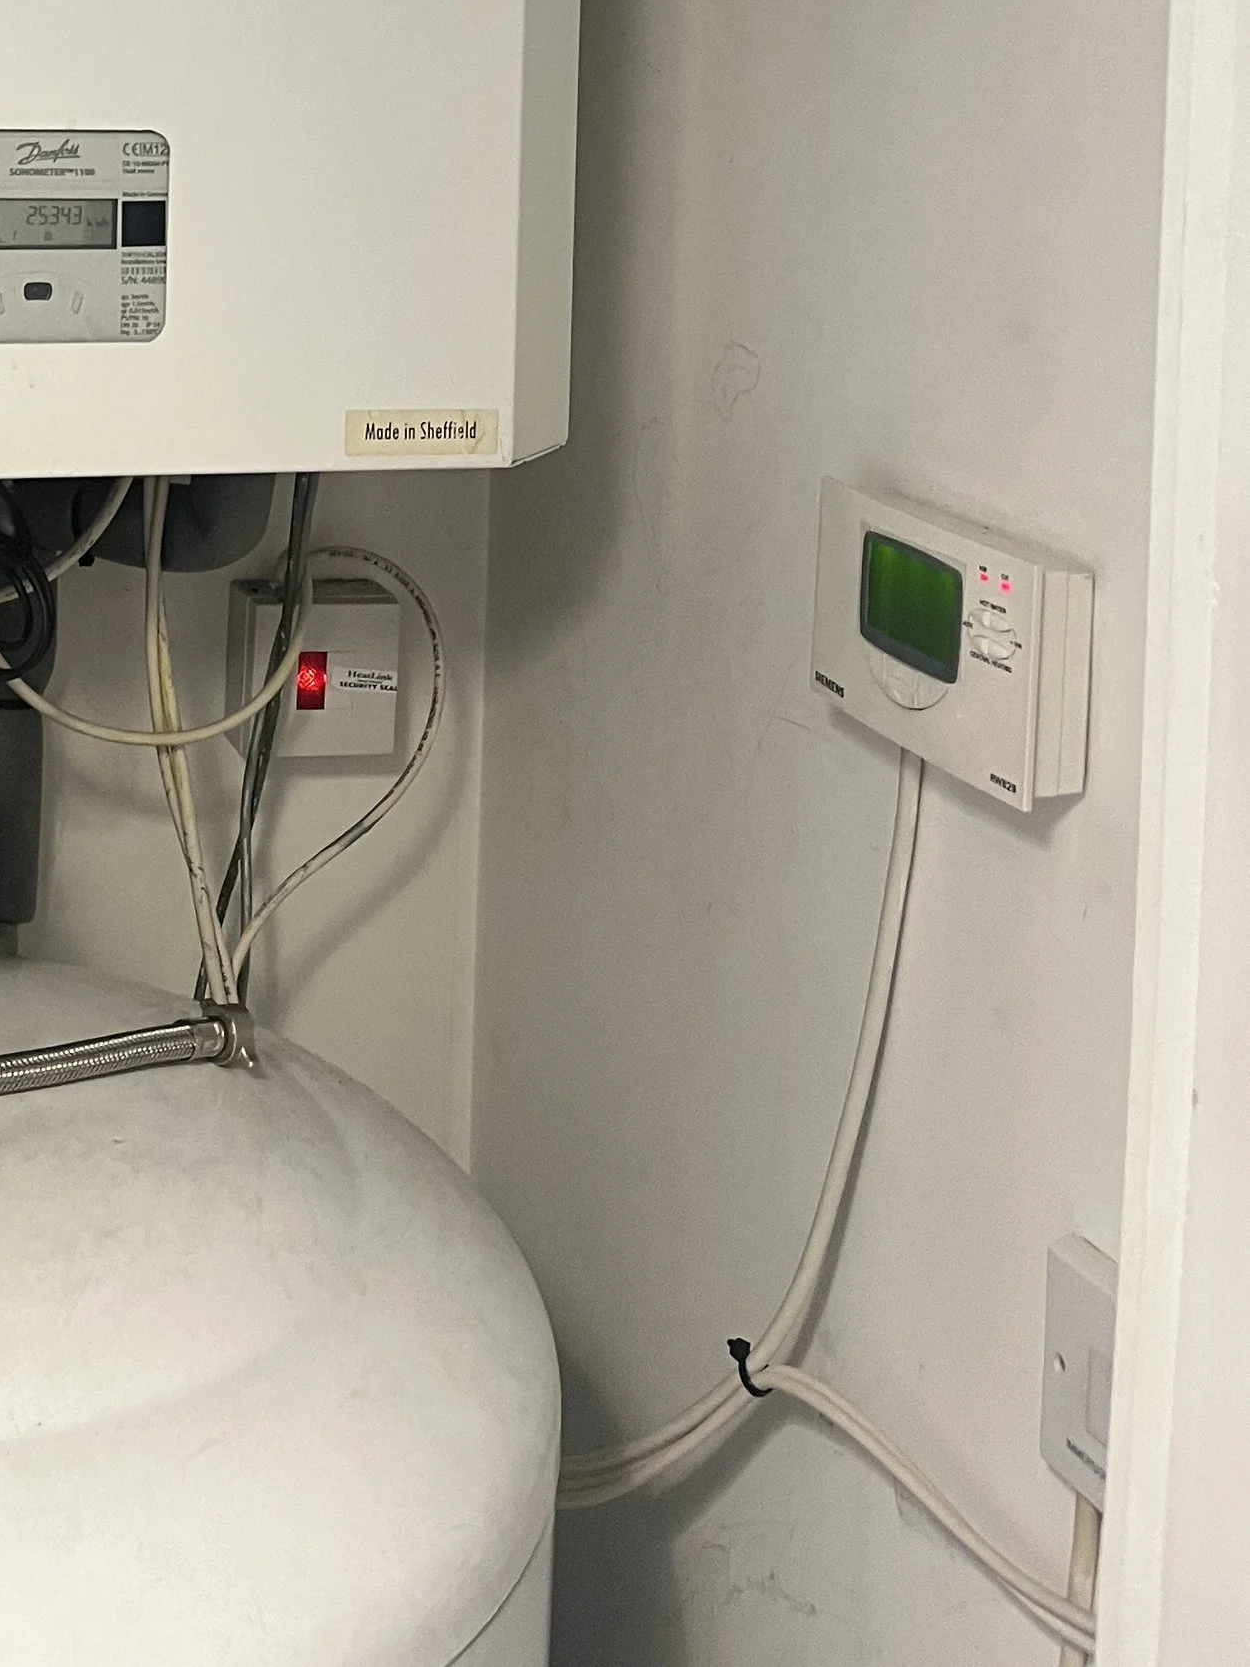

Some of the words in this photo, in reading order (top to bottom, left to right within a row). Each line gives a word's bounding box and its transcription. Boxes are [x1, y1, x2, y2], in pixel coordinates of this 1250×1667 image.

[16, 138, 80, 165] Danfoss
[26, 205, 83, 226] 25343
[365, 422, 400, 441] Made
[404, 423, 416, 440] in
[420, 420, 477, 440] Sheffield
[814, 670, 845, 699] SIEMENS
